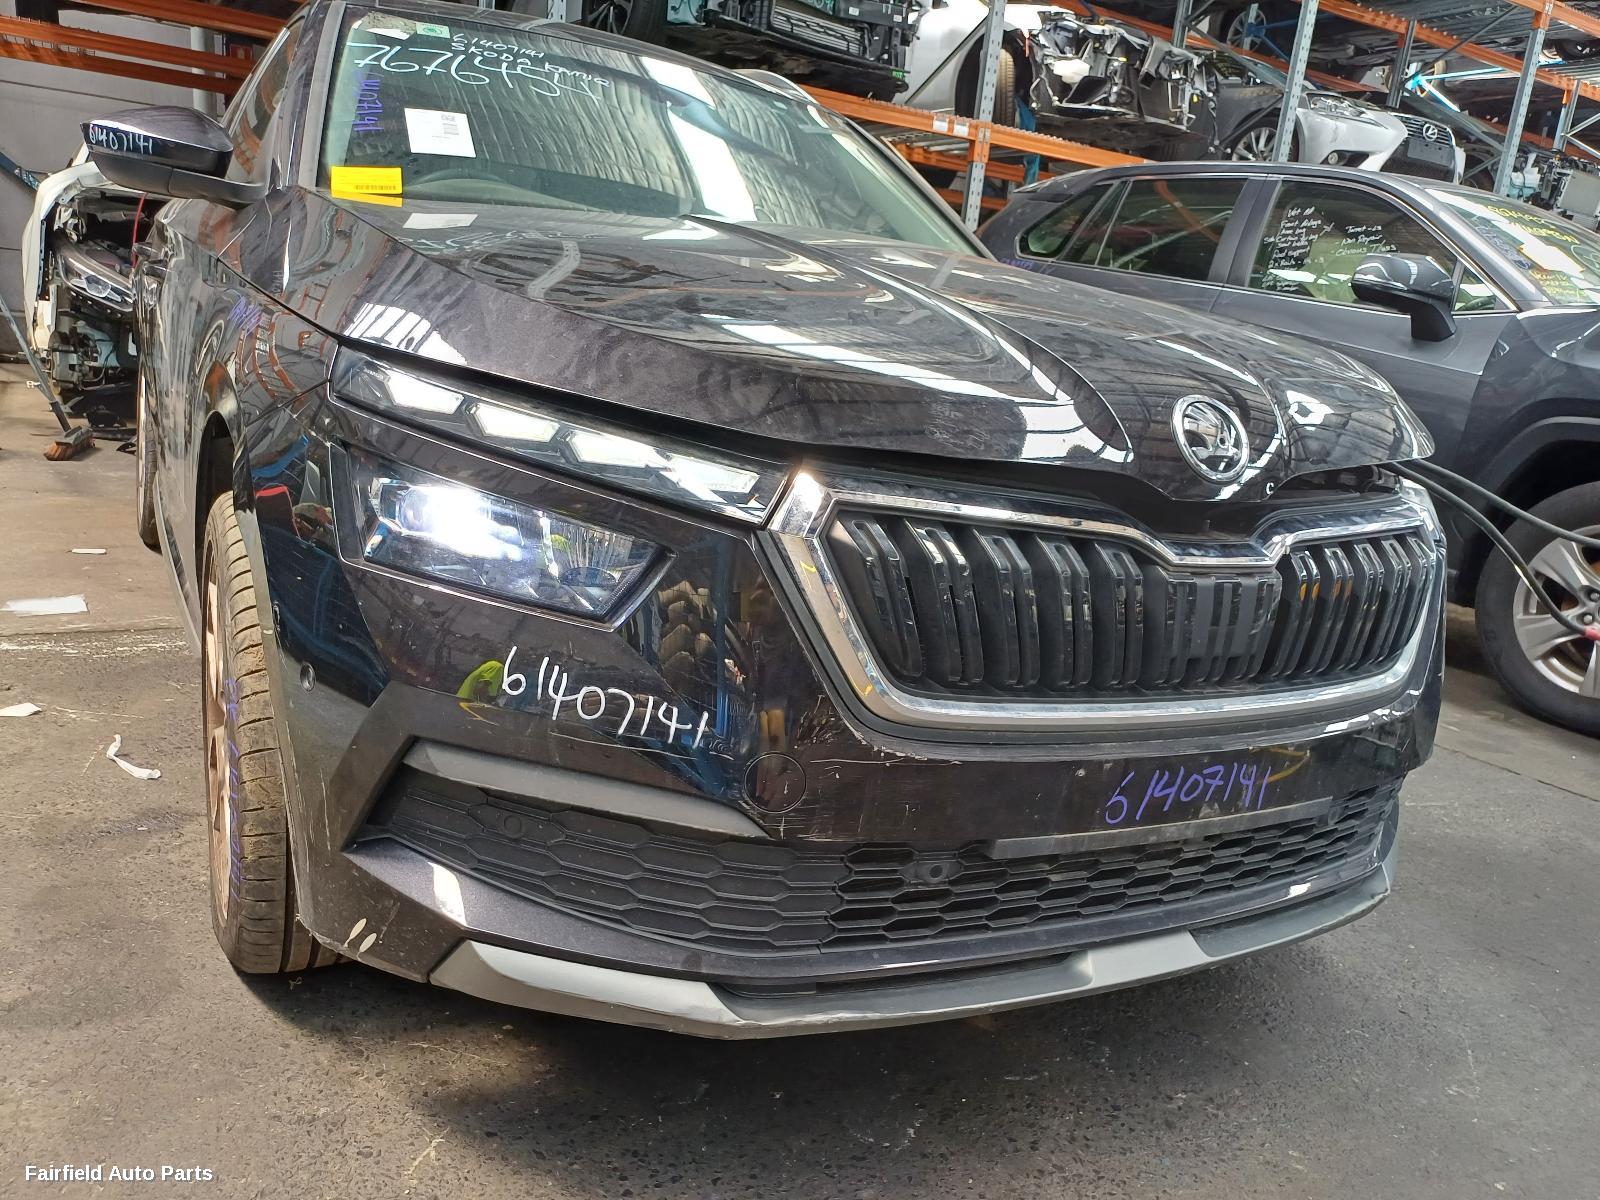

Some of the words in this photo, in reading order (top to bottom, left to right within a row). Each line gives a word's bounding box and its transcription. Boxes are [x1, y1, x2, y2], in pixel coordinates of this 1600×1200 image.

[451, 42, 532, 66] SKODA
[88, 124, 154, 154] 61407141
[502, 645, 709, 750] 61407141
[1105, 762, 1271, 824] 61407141
